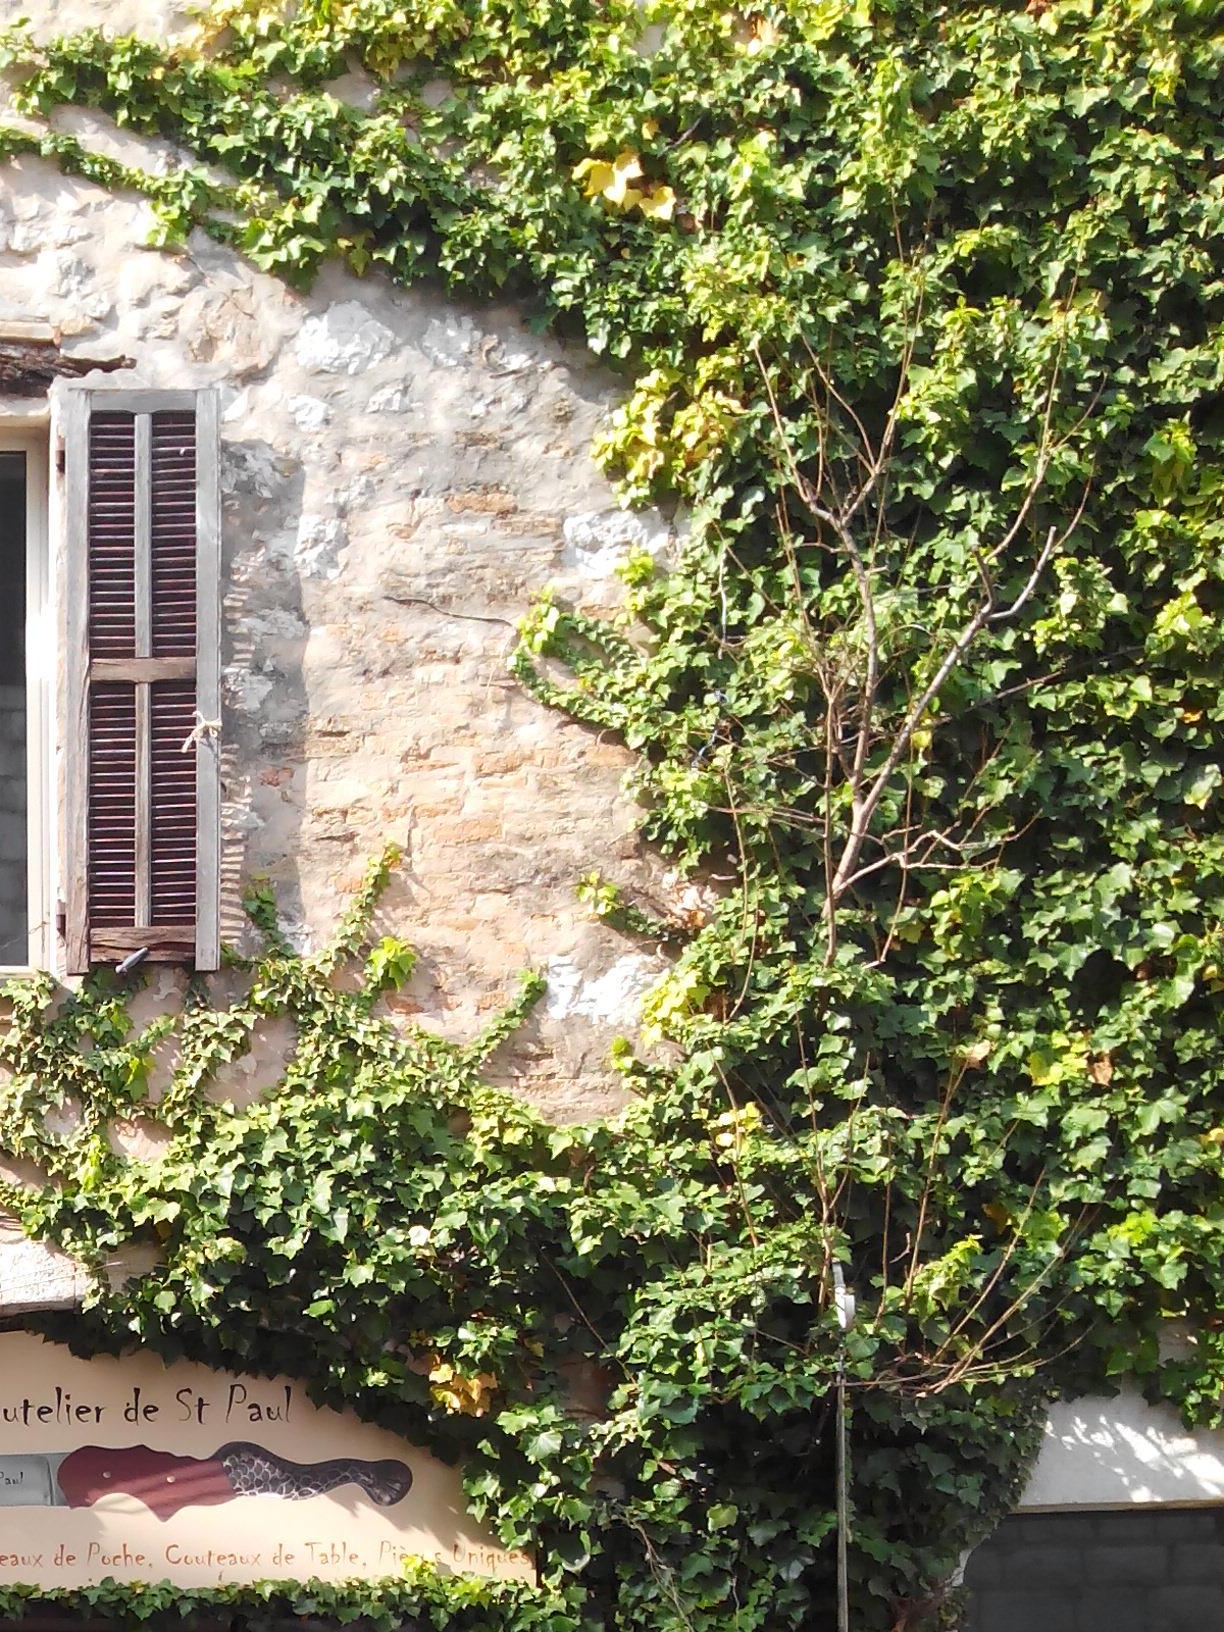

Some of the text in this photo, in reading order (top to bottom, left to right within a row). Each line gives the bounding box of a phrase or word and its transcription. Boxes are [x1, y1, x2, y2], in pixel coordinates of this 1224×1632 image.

[124, 1388, 159, 1424] de
[176, 1388, 210, 1425] St
[226, 1384, 292, 1424] Paul
[54, 1544, 76, 1567] de
[87, 1541, 154, 1569] Poche,
[165, 1543, 261, 1567] Couteaux
[272, 1541, 295, 1566] de
[304, 1541, 367, 1569] Table,
[453, 1544, 530, 1572] Uniques
